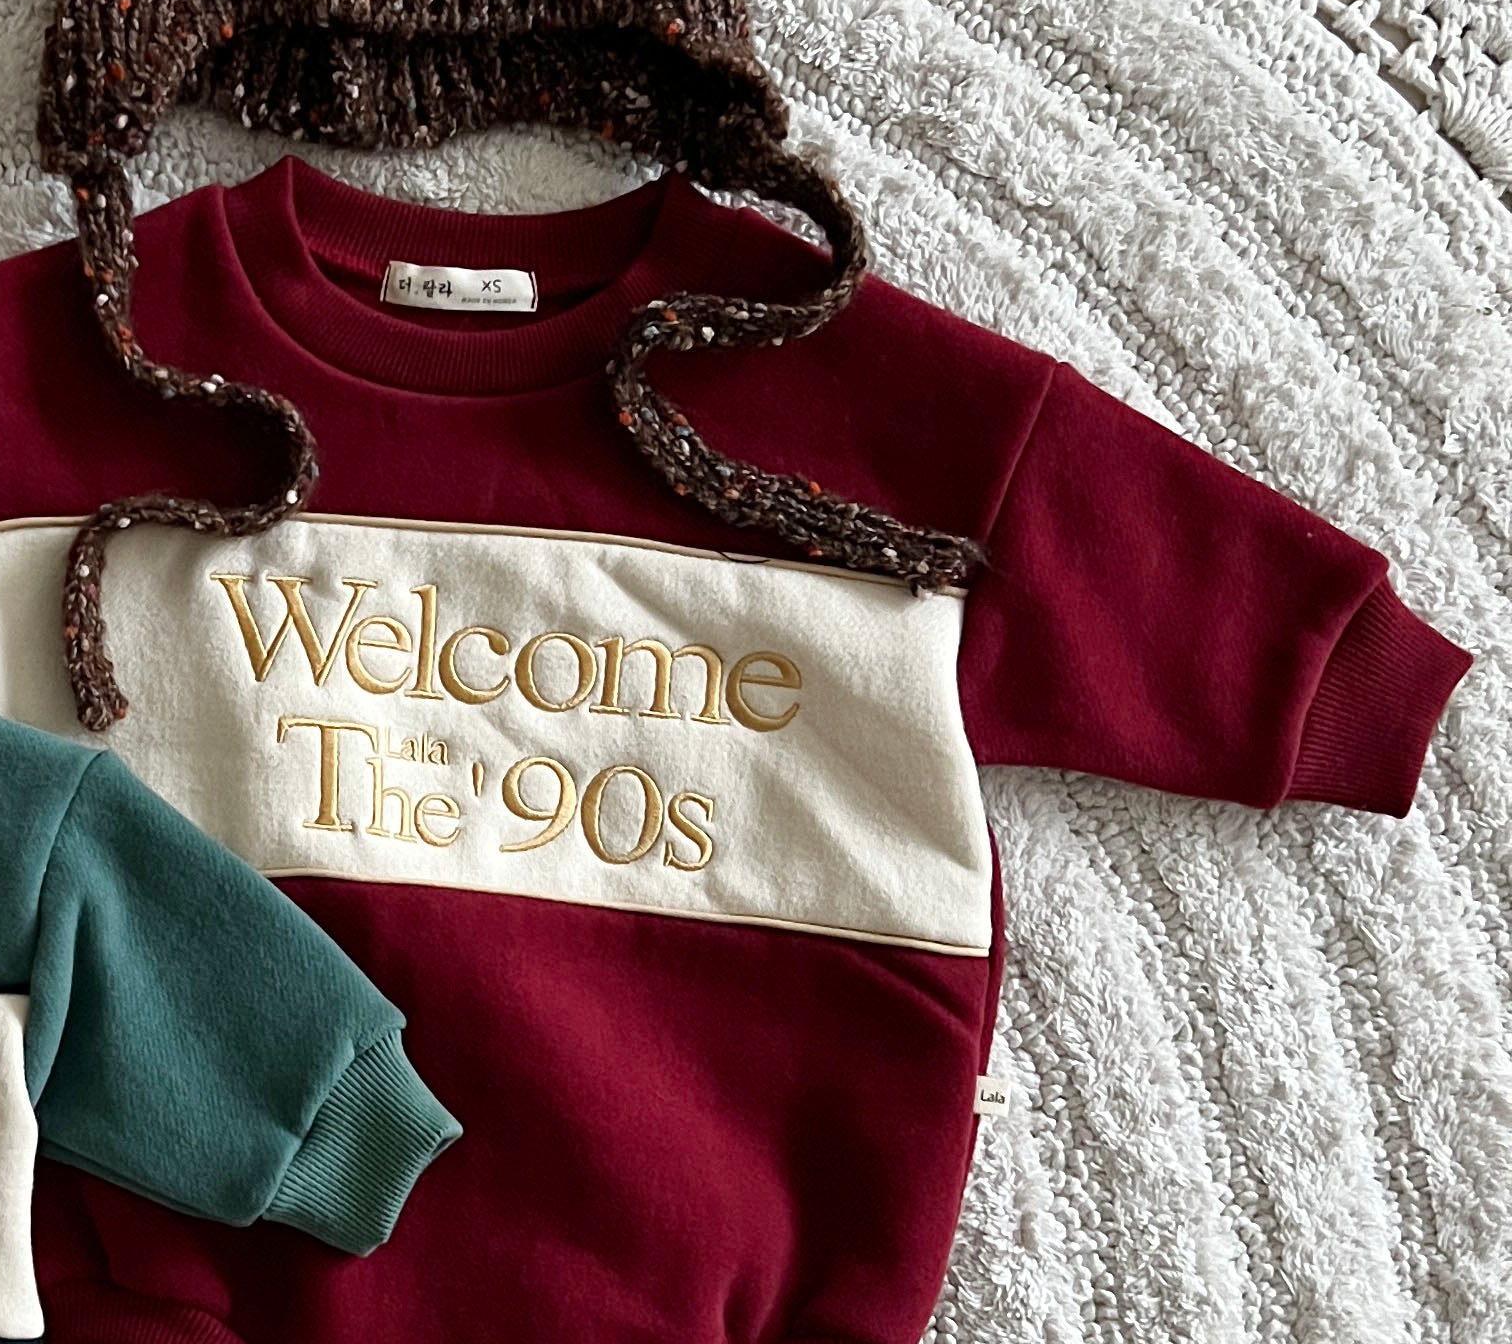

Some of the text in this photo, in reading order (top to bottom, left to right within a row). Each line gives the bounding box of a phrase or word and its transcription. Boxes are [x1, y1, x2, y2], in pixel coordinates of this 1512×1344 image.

[480, 279, 503, 294] XS
[208, 571, 804, 733] Welcome
[386, 726, 449, 766] Lala
[276, 716, 716, 872] The '90s
[980, 1089, 1006, 1104] Lala
